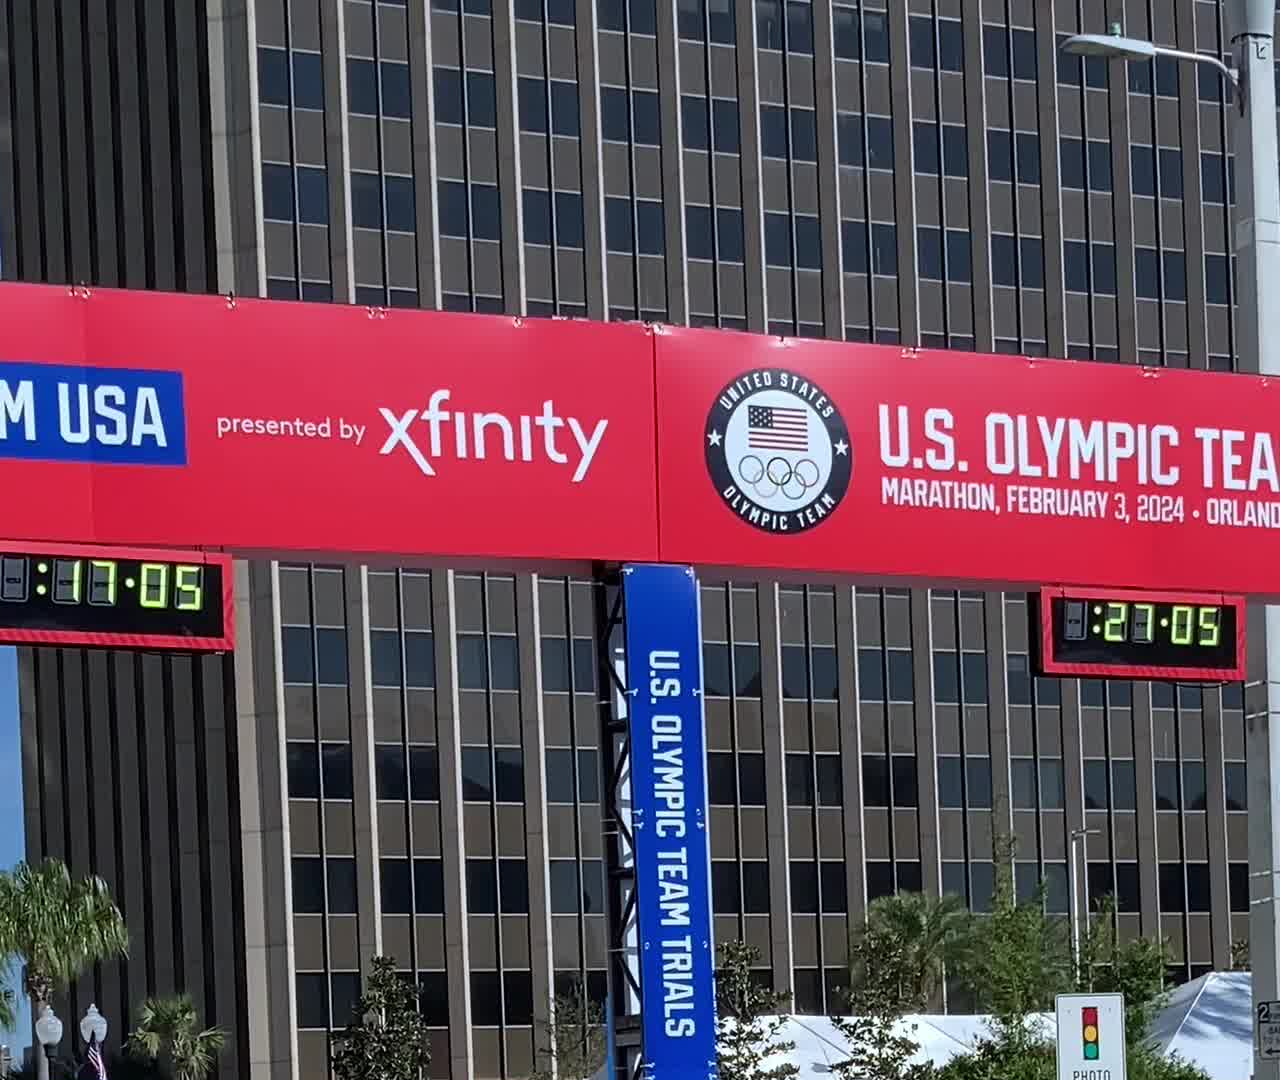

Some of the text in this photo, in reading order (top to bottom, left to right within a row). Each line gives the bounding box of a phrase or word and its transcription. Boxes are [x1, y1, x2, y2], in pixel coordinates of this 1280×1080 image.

[58, 382, 168, 448] USA
[720, 371, 772, 410] UNITED
[780, 373, 834, 418] STATES
[217, 413, 366, 446] presented by
[378, 389, 609, 482] xfinity
[878, 403, 969, 472] U.S.
[985, 411, 1180, 487] OLYMPIC
[723, 485, 835, 530] OLYMPIC TEAM
[881, 476, 1001, 516] MARATHON,
[1006, 484, 1108, 519] FEBRUARY
[1114, 493, 1130, 525] 3,
[1136, 494, 1185, 524] 2024
[649, 649, 696, 1039] U.S. OLYMPIC TEAM TRIALS
